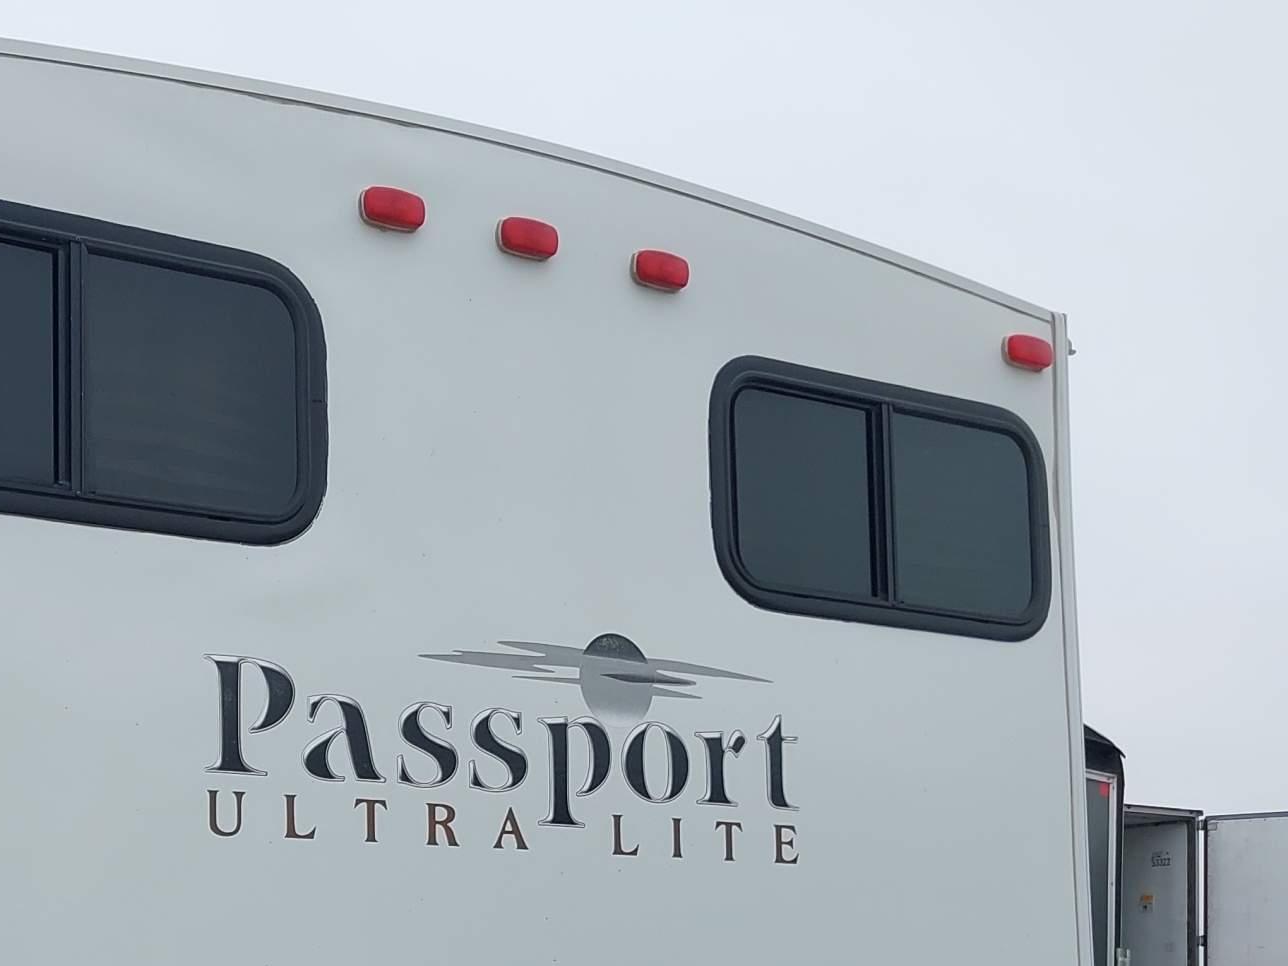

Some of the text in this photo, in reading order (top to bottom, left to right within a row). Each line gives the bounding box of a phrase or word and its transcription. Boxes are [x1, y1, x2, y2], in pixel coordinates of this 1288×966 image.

[203, 652, 800, 828] Passport
[206, 788, 801, 866] ULTRA LITE
